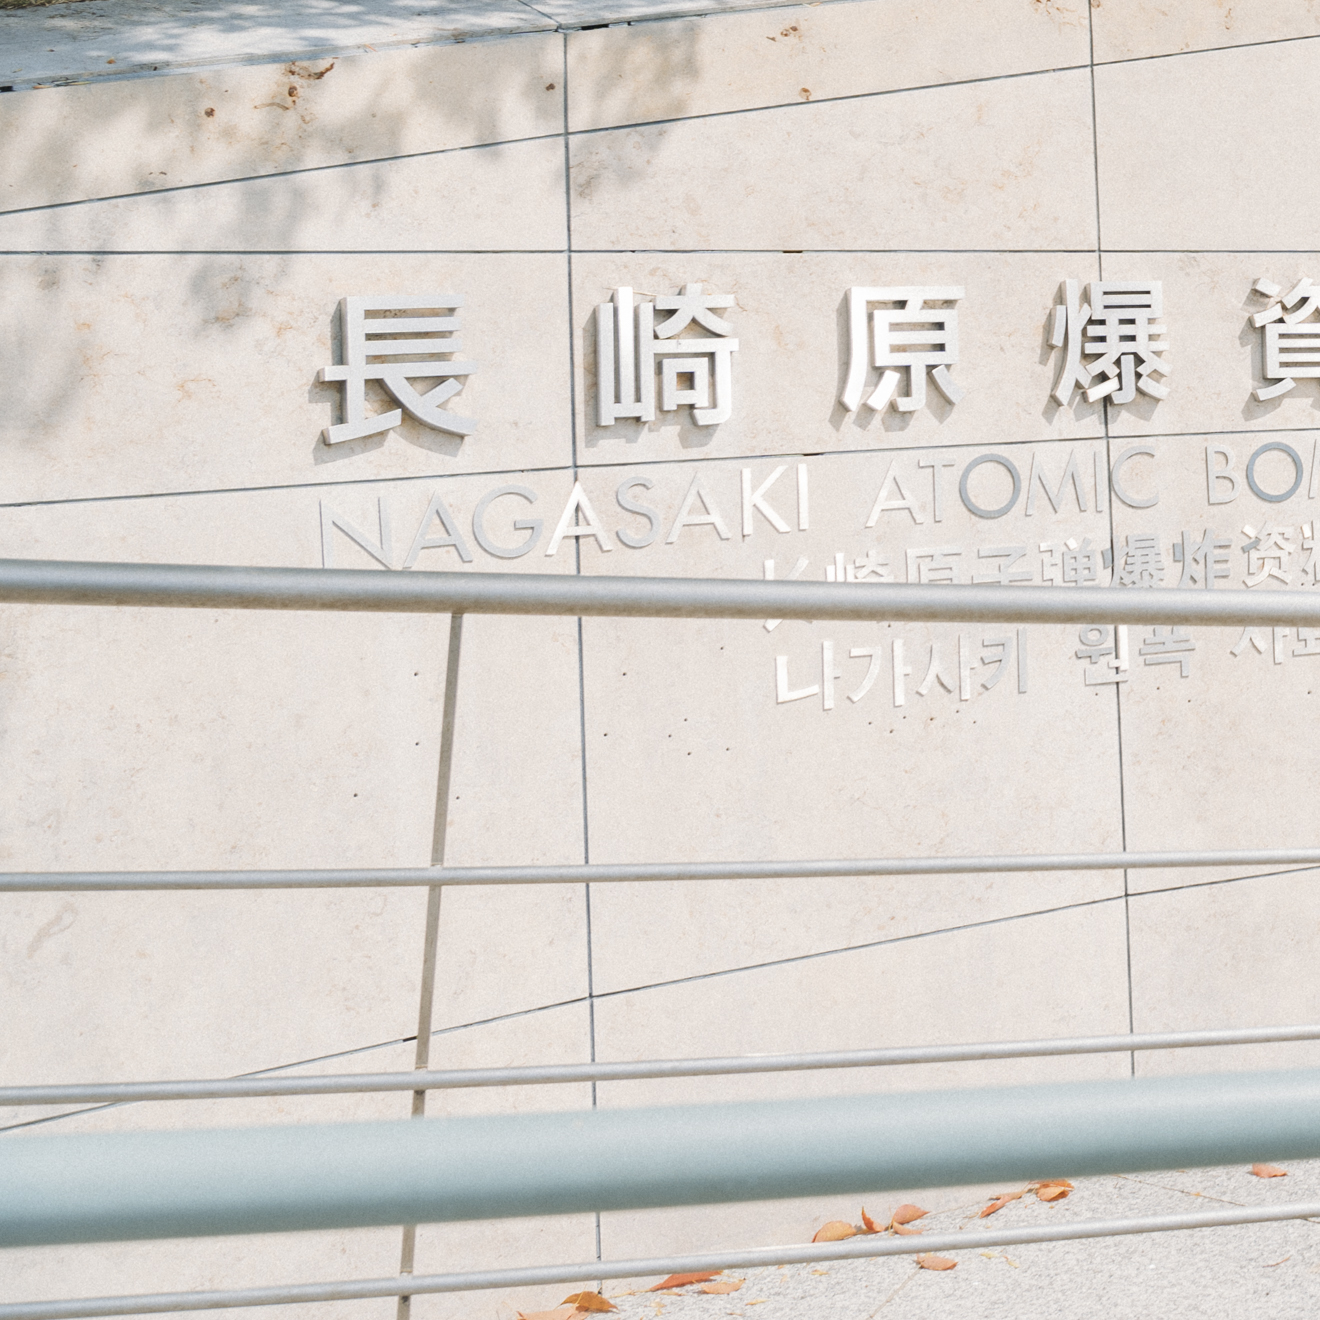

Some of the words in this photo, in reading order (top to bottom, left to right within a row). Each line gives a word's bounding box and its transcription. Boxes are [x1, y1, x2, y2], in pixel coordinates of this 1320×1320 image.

[319, 462, 811, 569] NAGASAKI
[864, 445, 1160, 530] ATOMIC
[775, 627, 1028, 711] 나가사키
